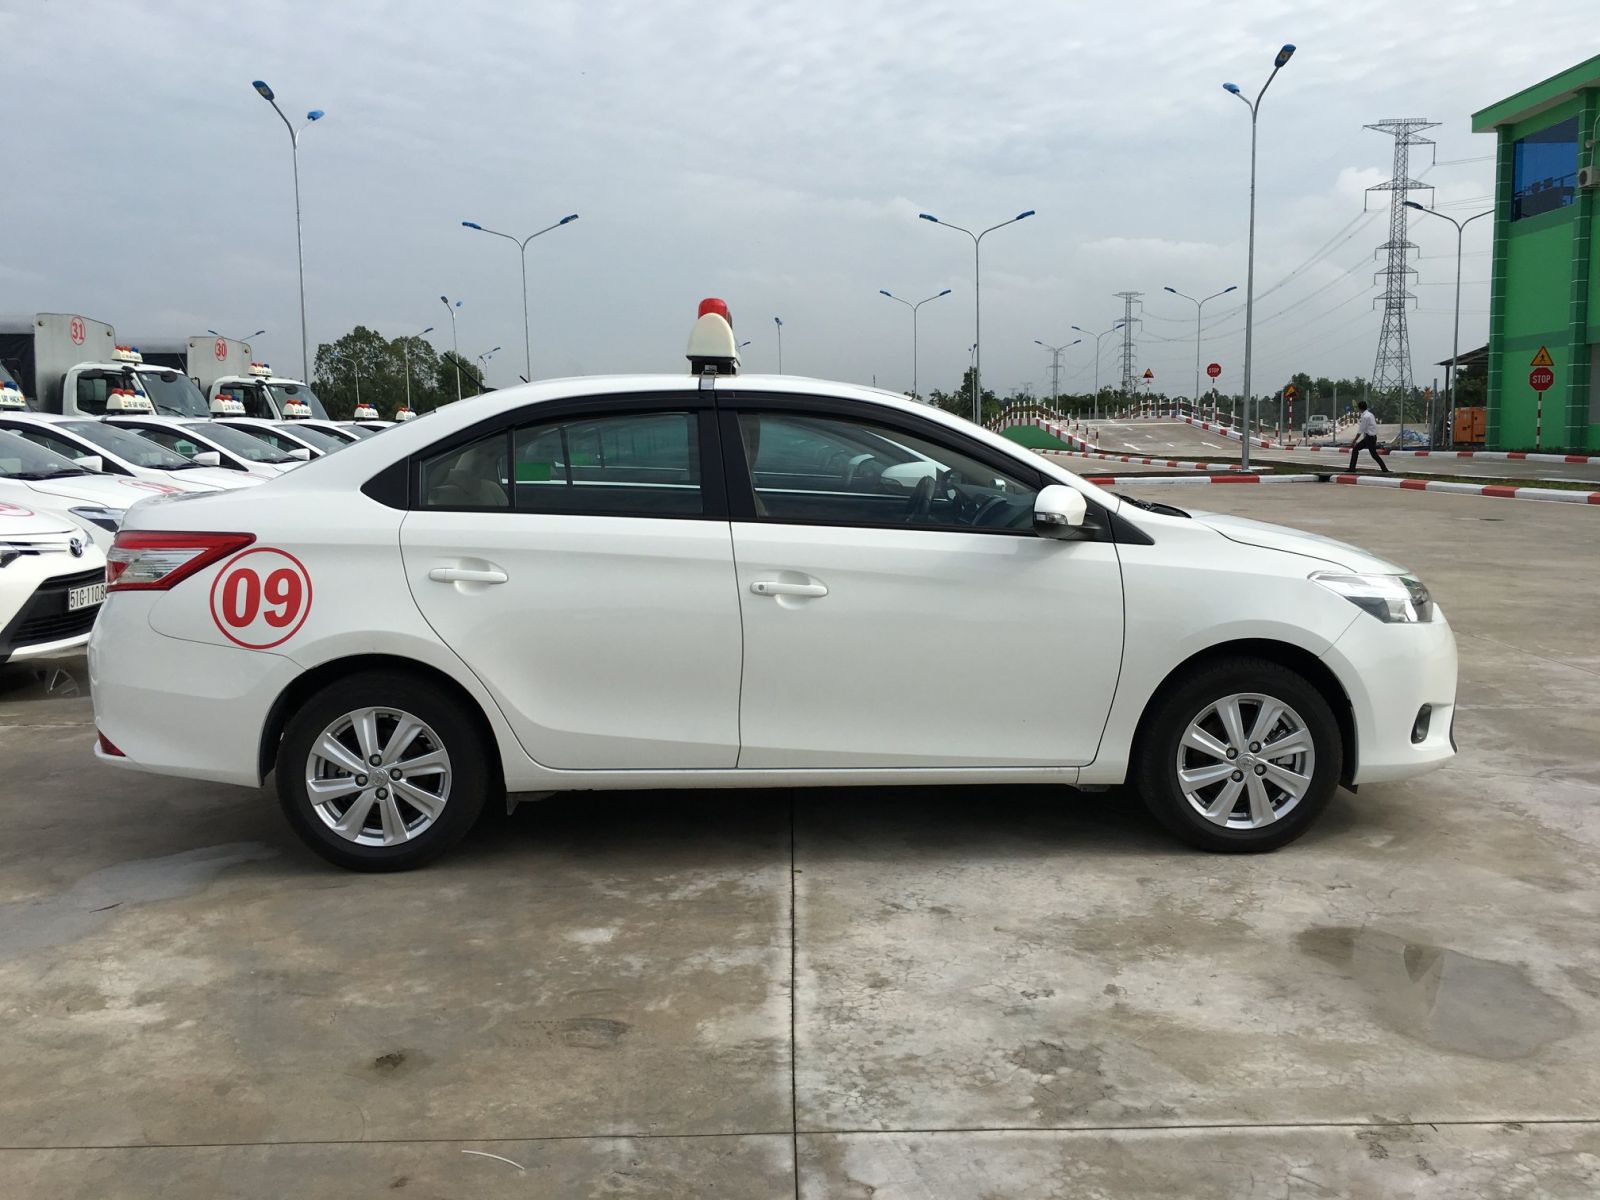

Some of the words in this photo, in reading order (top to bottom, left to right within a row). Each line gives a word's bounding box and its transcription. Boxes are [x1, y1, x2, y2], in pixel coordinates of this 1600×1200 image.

[72, 321, 85, 340] 31
[216, 343, 225, 357] 30
[1532, 375, 1551, 384] STOP
[222, 567, 303, 629] 09
